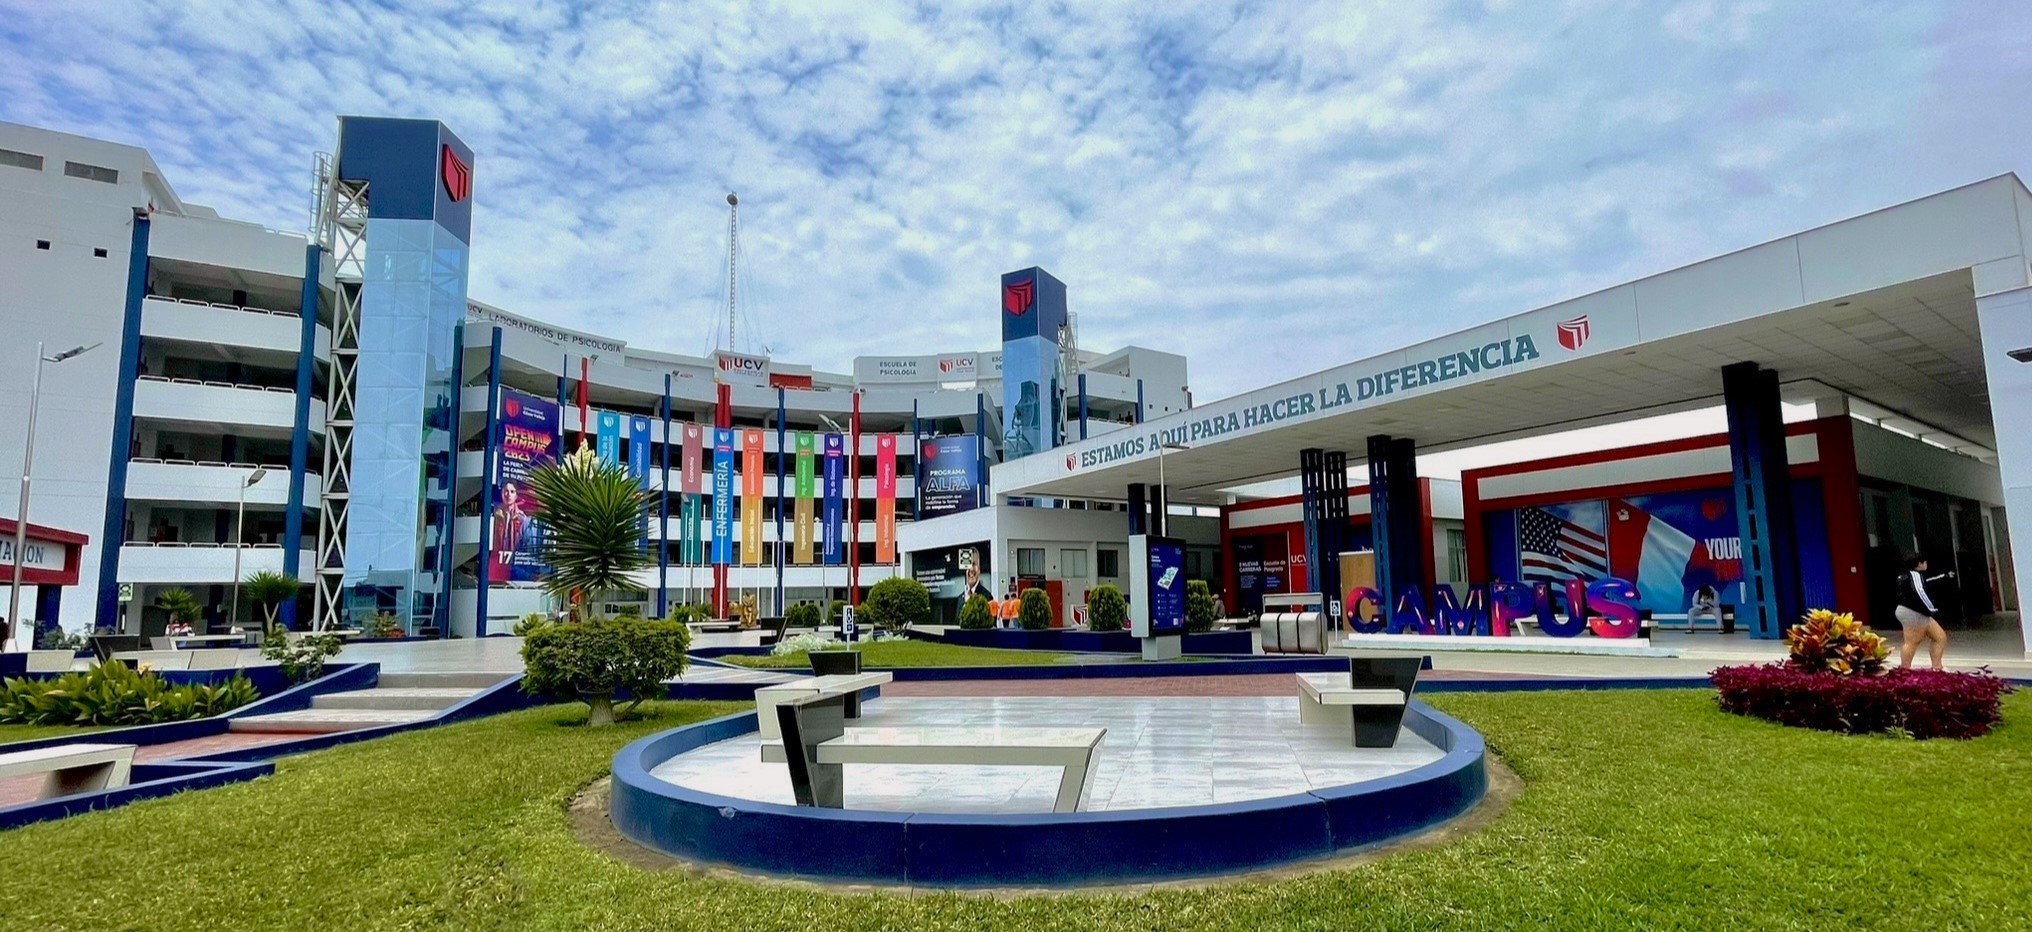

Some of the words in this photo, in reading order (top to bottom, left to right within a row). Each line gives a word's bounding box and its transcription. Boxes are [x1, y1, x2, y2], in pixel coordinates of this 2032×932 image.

[489, 313, 554, 338] LABORATORIOS
[557, 332, 569, 342] DE
[734, 357, 764, 371] UCV
[956, 358, 974, 367] UCV
[1082, 436, 1145, 468] ESTAMOS
[1148, 421, 1189, 452] AQUÍ
[1190, 411, 1240, 441] PARA
[1243, 392, 1316, 428] HACER
[1320, 382, 1353, 410] LA
[1356, 333, 1540, 400] DIFERENCIA
[505, 424, 535, 441] OPEN
[504, 436, 547, 454] CAMPUS
[930, 469, 966, 477] PROGRAMA
[925, 476, 971, 493] ALFA
[714, 461, 729, 537] ENFERMERÍA
[498, 550, 513, 564] 17
[1705, 537, 1743, 560] YOUR
[1345, 577, 1642, 638] CAMPUS
